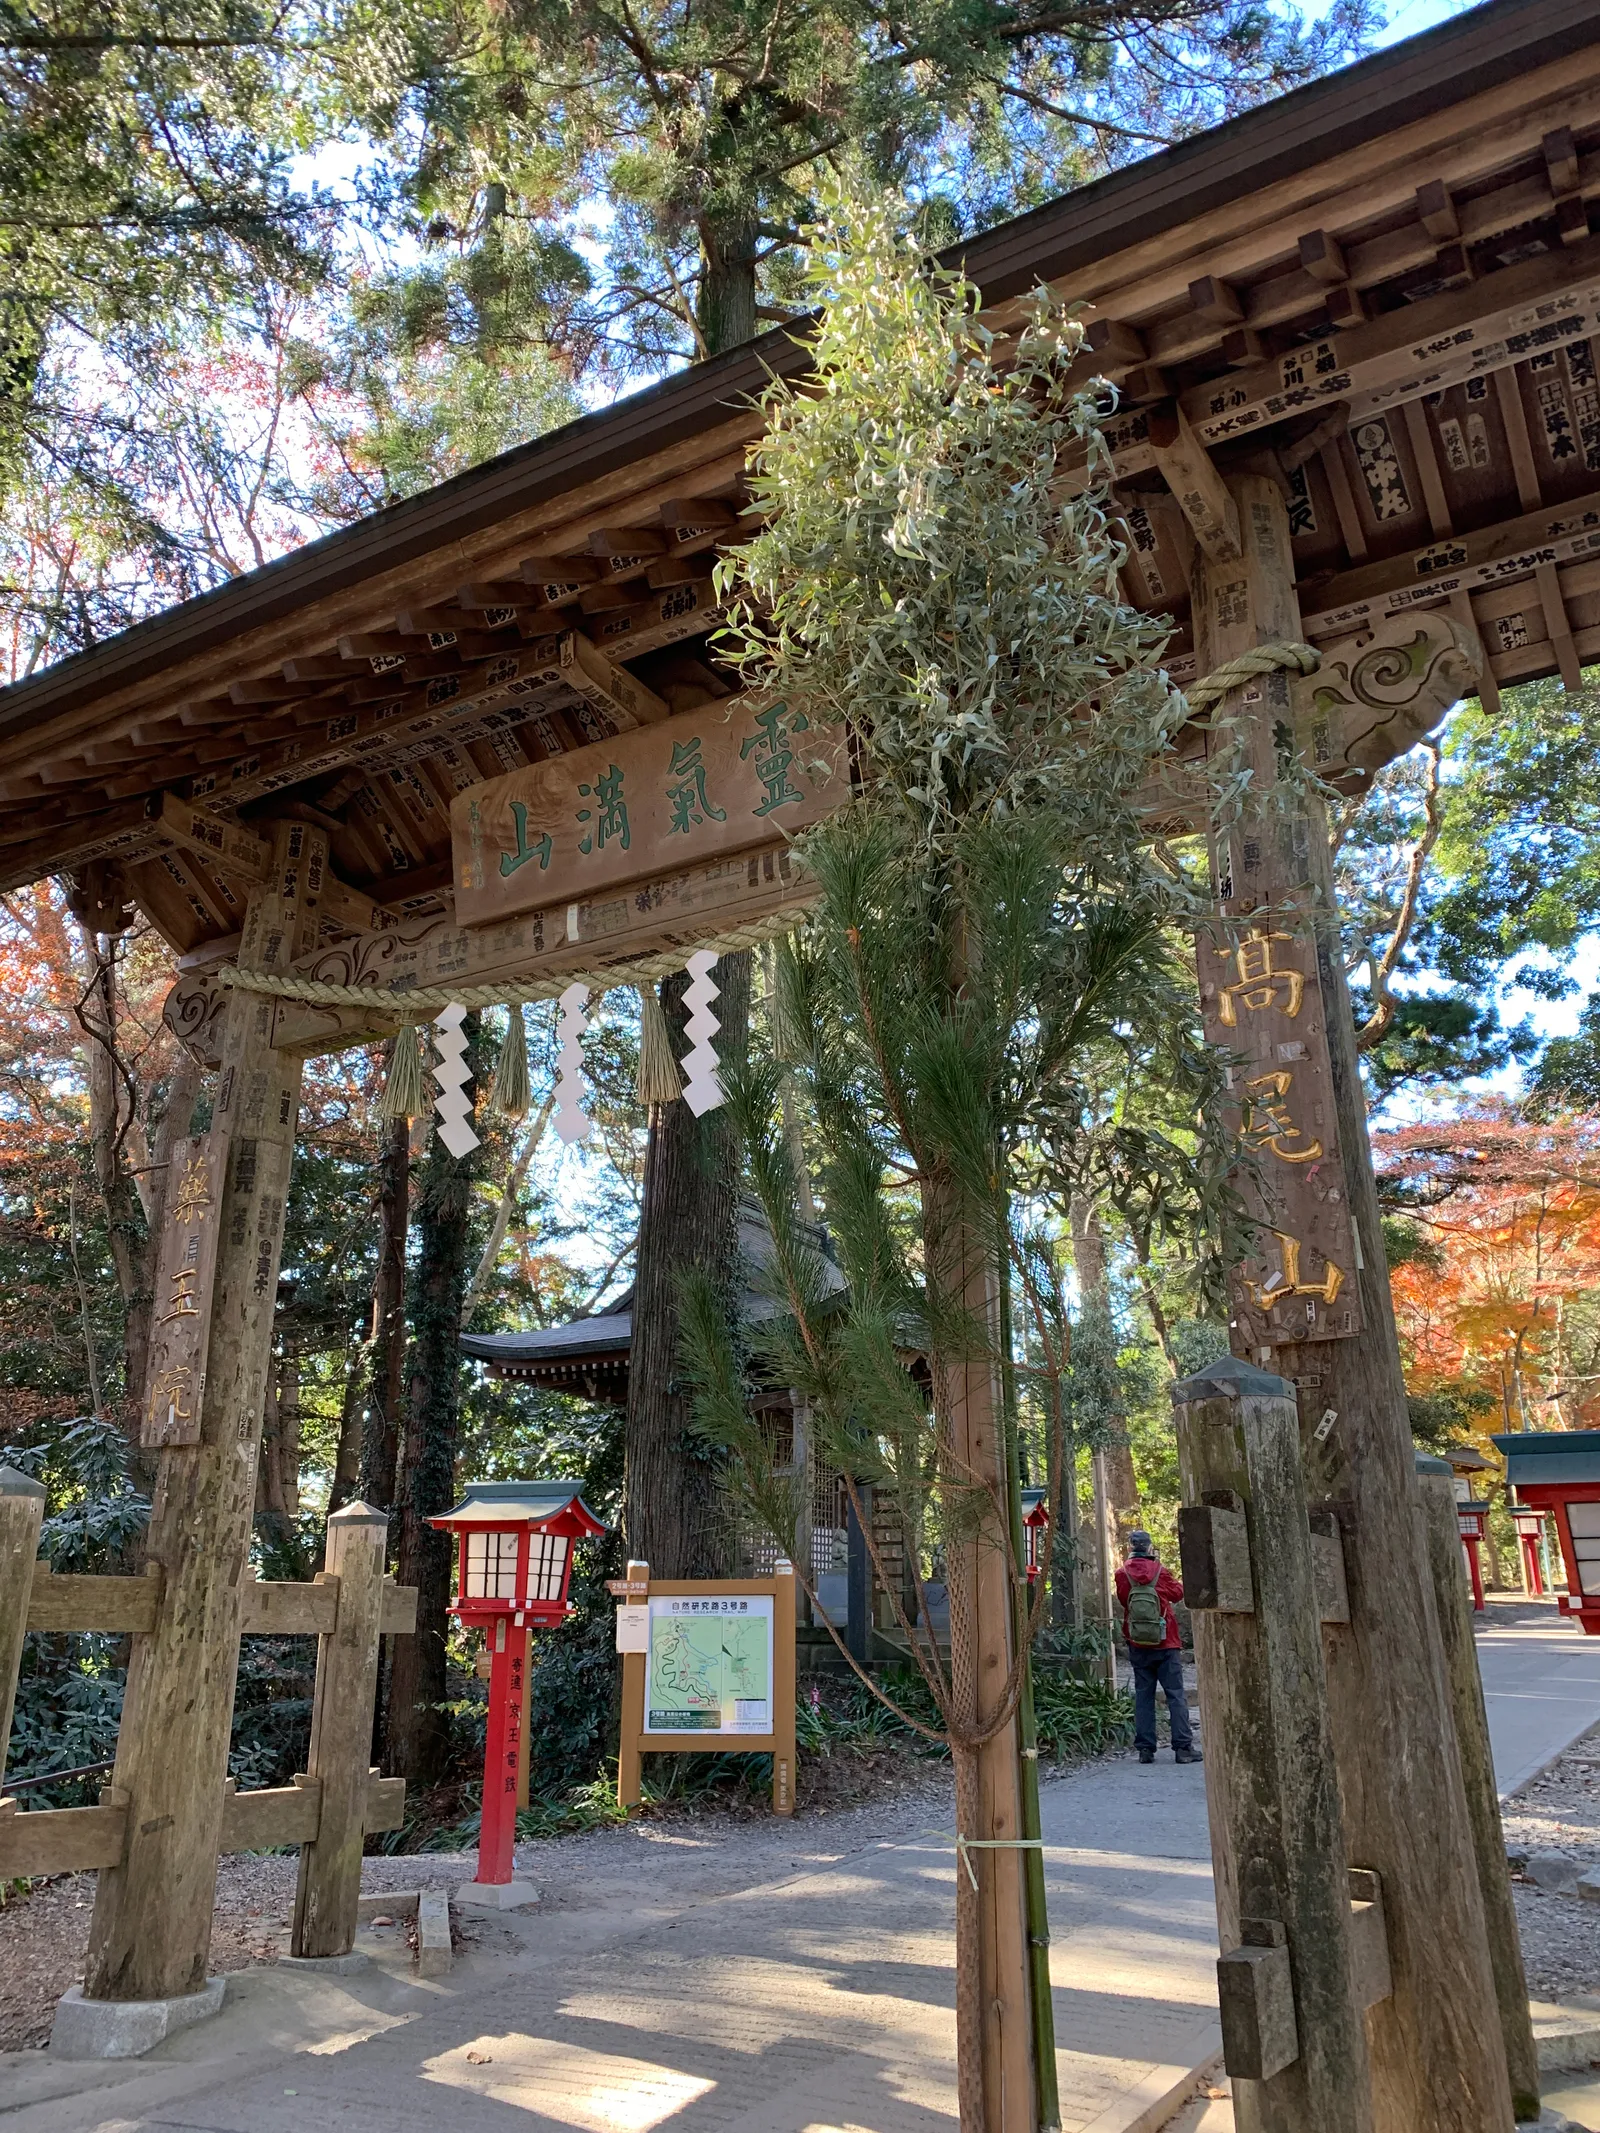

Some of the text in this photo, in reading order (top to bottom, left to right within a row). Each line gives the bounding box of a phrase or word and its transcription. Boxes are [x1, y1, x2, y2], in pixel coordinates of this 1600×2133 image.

[1127, 507, 1155, 552] 吉野
[671, 1601, 748, 1611] 自然研究路3号路
[504, 1656, 523, 1794] 寄進 京王電鉄
